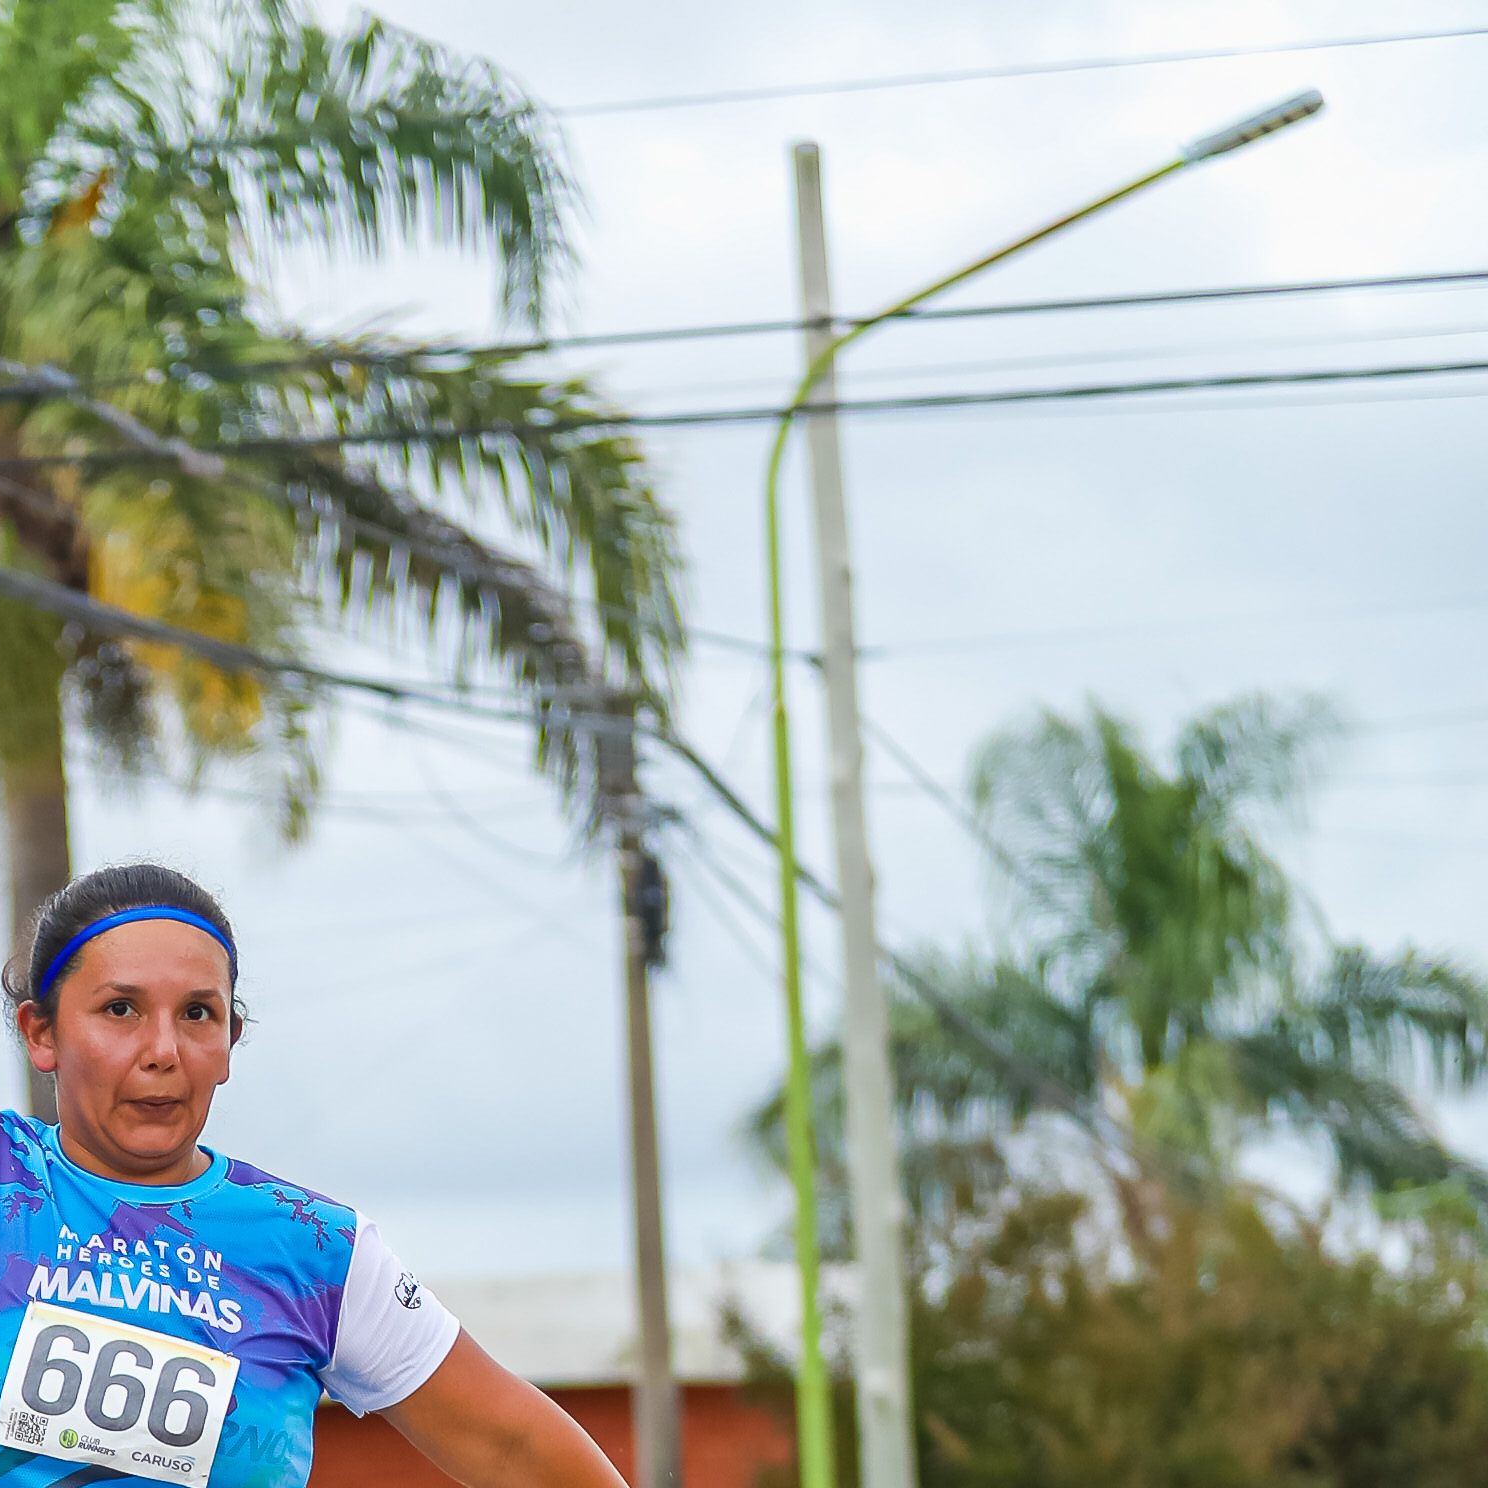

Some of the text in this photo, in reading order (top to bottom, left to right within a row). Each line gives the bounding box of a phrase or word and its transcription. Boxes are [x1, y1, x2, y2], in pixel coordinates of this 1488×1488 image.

[56, 1243, 220, 1291] HEROES DE
[58, 1224, 222, 1272] MARATÓN
[26, 1264, 242, 1334] MALVINAS
[20, 1324, 216, 1448] 666
[77, 1442, 116, 1456] RUNNER'S
[80, 1434, 101, 1446] CLUB
[131, 1451, 193, 1473] CARUSO
